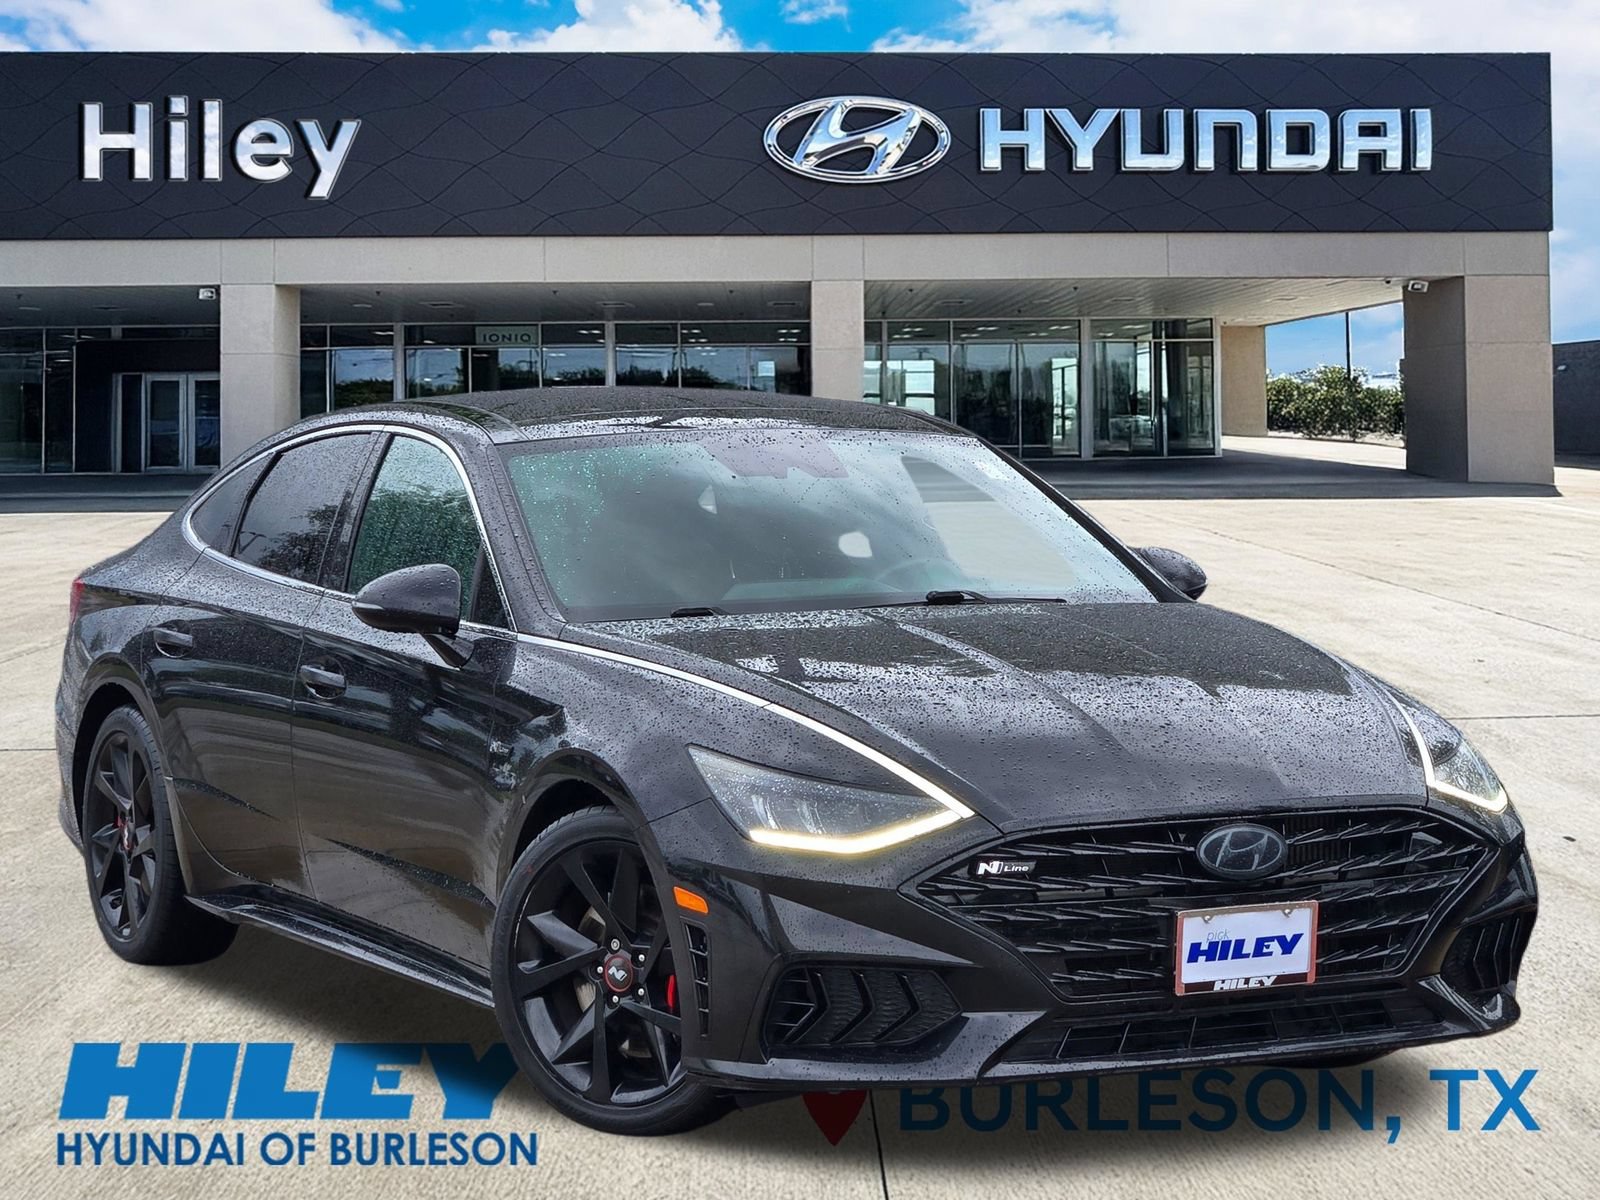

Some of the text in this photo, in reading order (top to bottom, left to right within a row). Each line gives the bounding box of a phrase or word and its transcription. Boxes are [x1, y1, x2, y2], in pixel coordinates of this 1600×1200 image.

[80, 95, 361, 199] Hiley
[979, 107, 1433, 172] HYUNDAI
[1004, 863, 1029, 872] Line
[1187, 933, 1304, 963] HILEY
[1206, 929, 1230, 944] pick
[1213, 975, 1277, 991] HILEY
